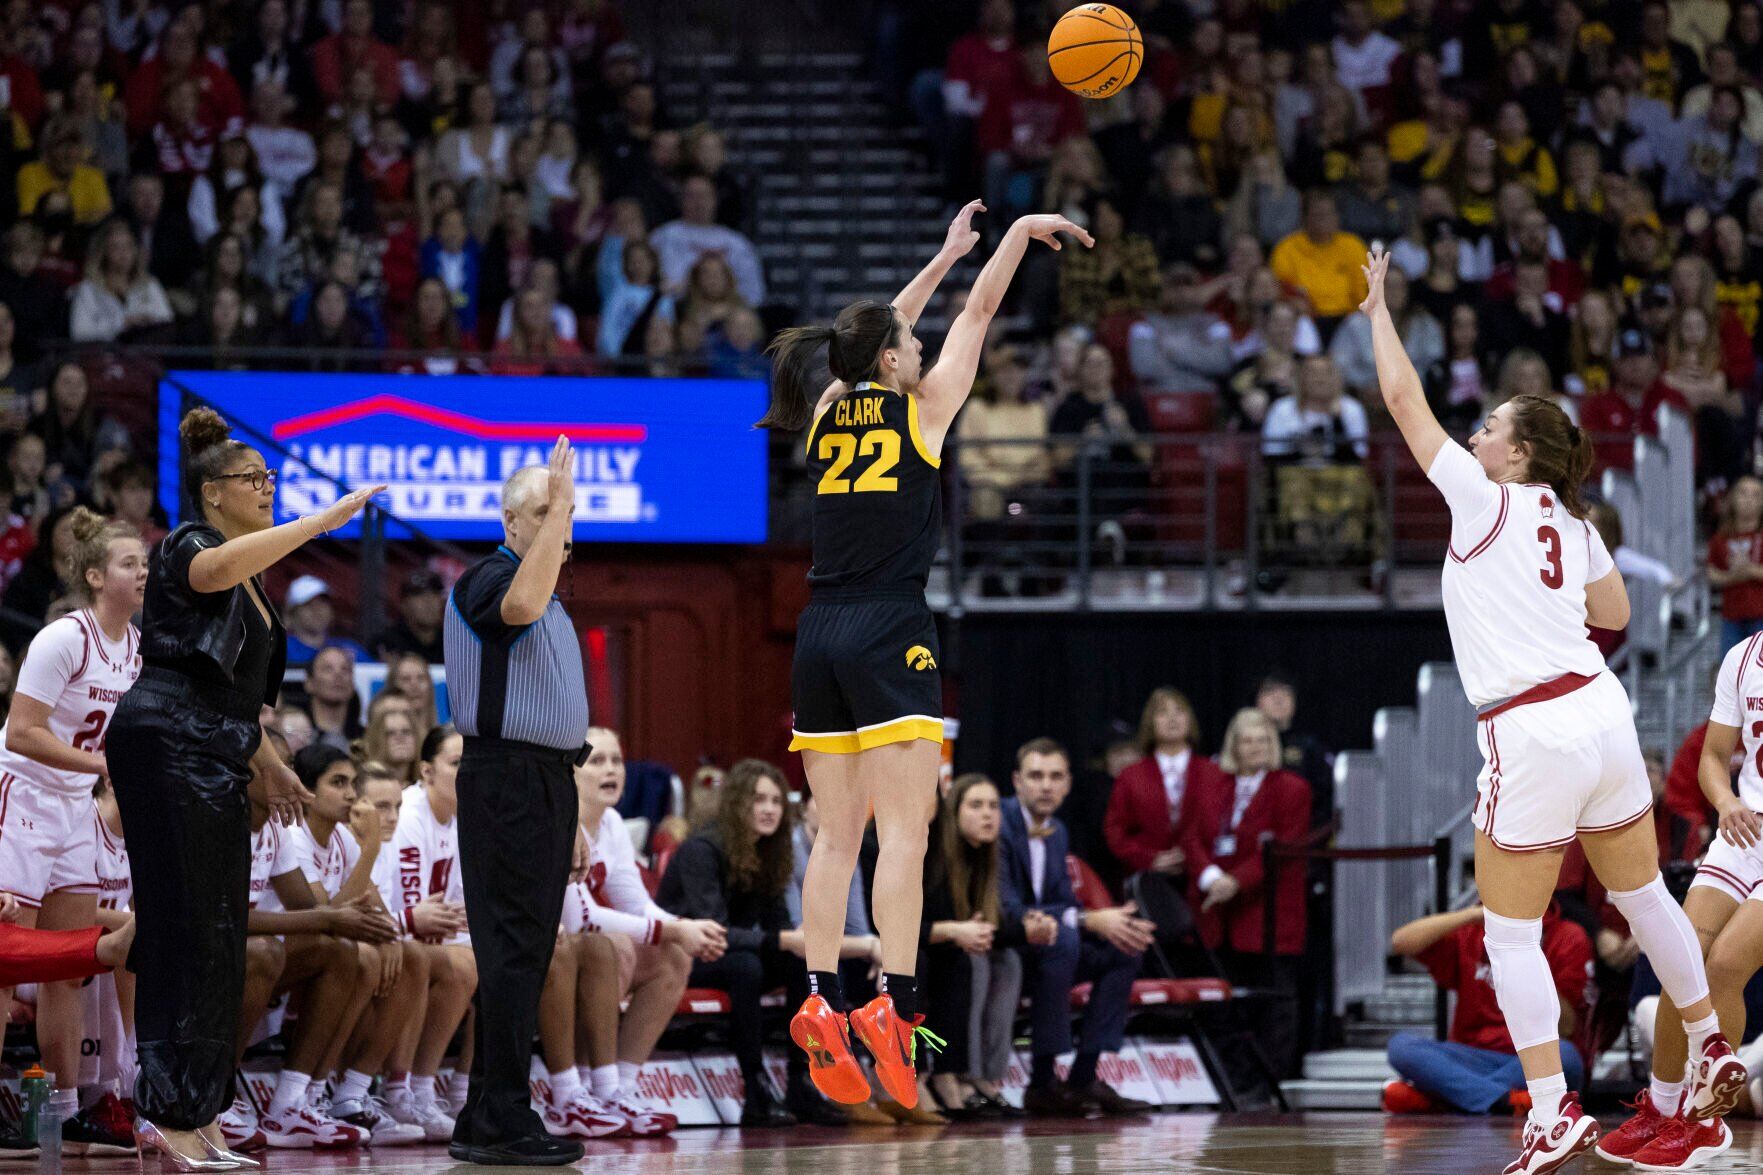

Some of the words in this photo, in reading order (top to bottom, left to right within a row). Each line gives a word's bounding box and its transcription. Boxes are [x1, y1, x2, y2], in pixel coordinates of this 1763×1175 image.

[835, 397, 885, 426] CLARK
[282, 443, 487, 481] AMERICAN
[817, 429, 902, 495] 22
[1537, 525, 1564, 590] 3
